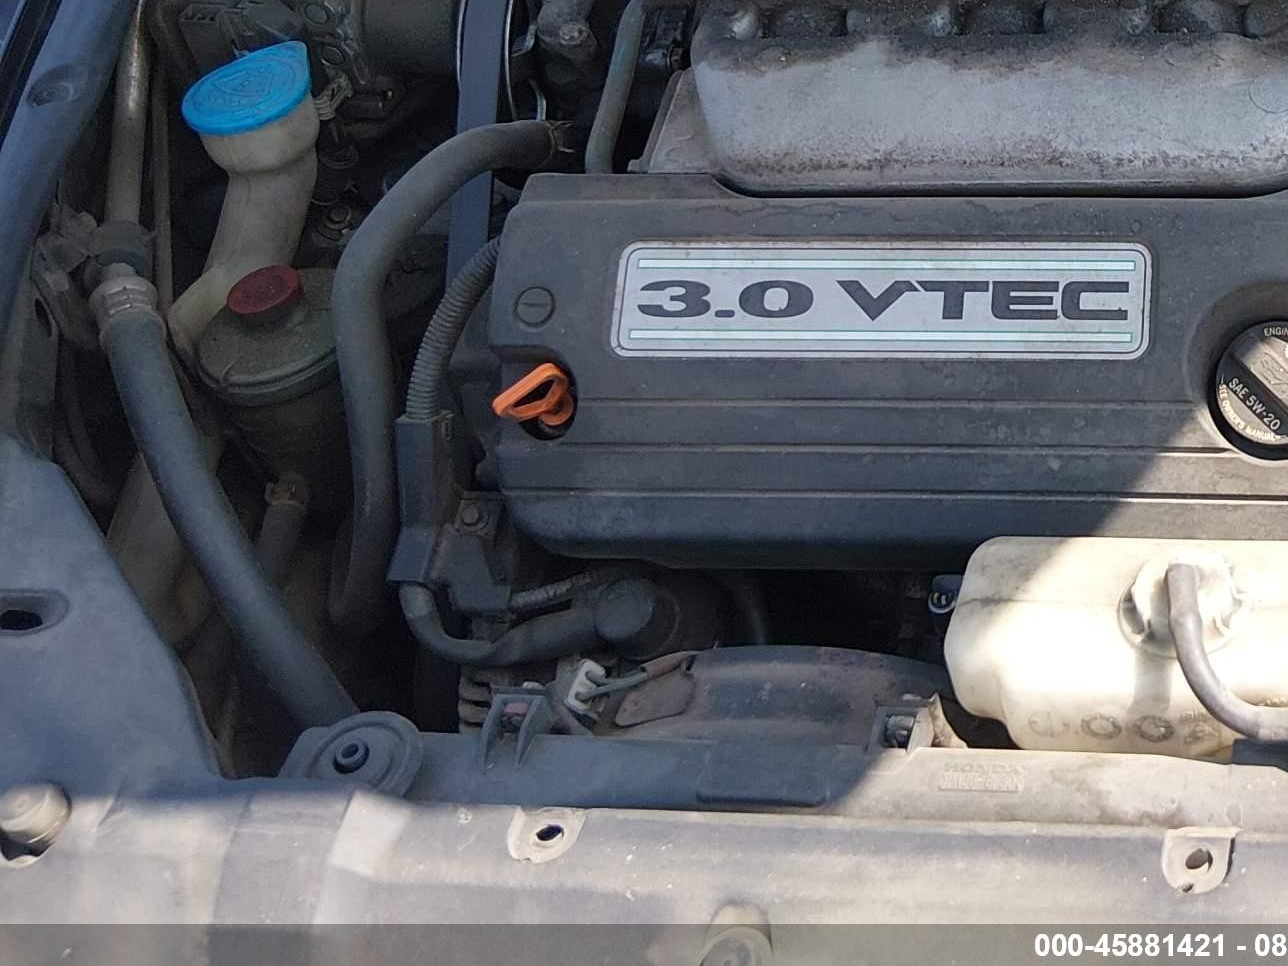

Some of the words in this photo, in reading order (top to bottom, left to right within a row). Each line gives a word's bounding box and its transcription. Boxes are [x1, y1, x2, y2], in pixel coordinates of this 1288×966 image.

[636, 279, 815, 319] 3.0
[836, 279, 1130, 322] VTEC
[1228, 378, 1249, 400] SAE
[1245, 395, 1281, 431] 5W-20
